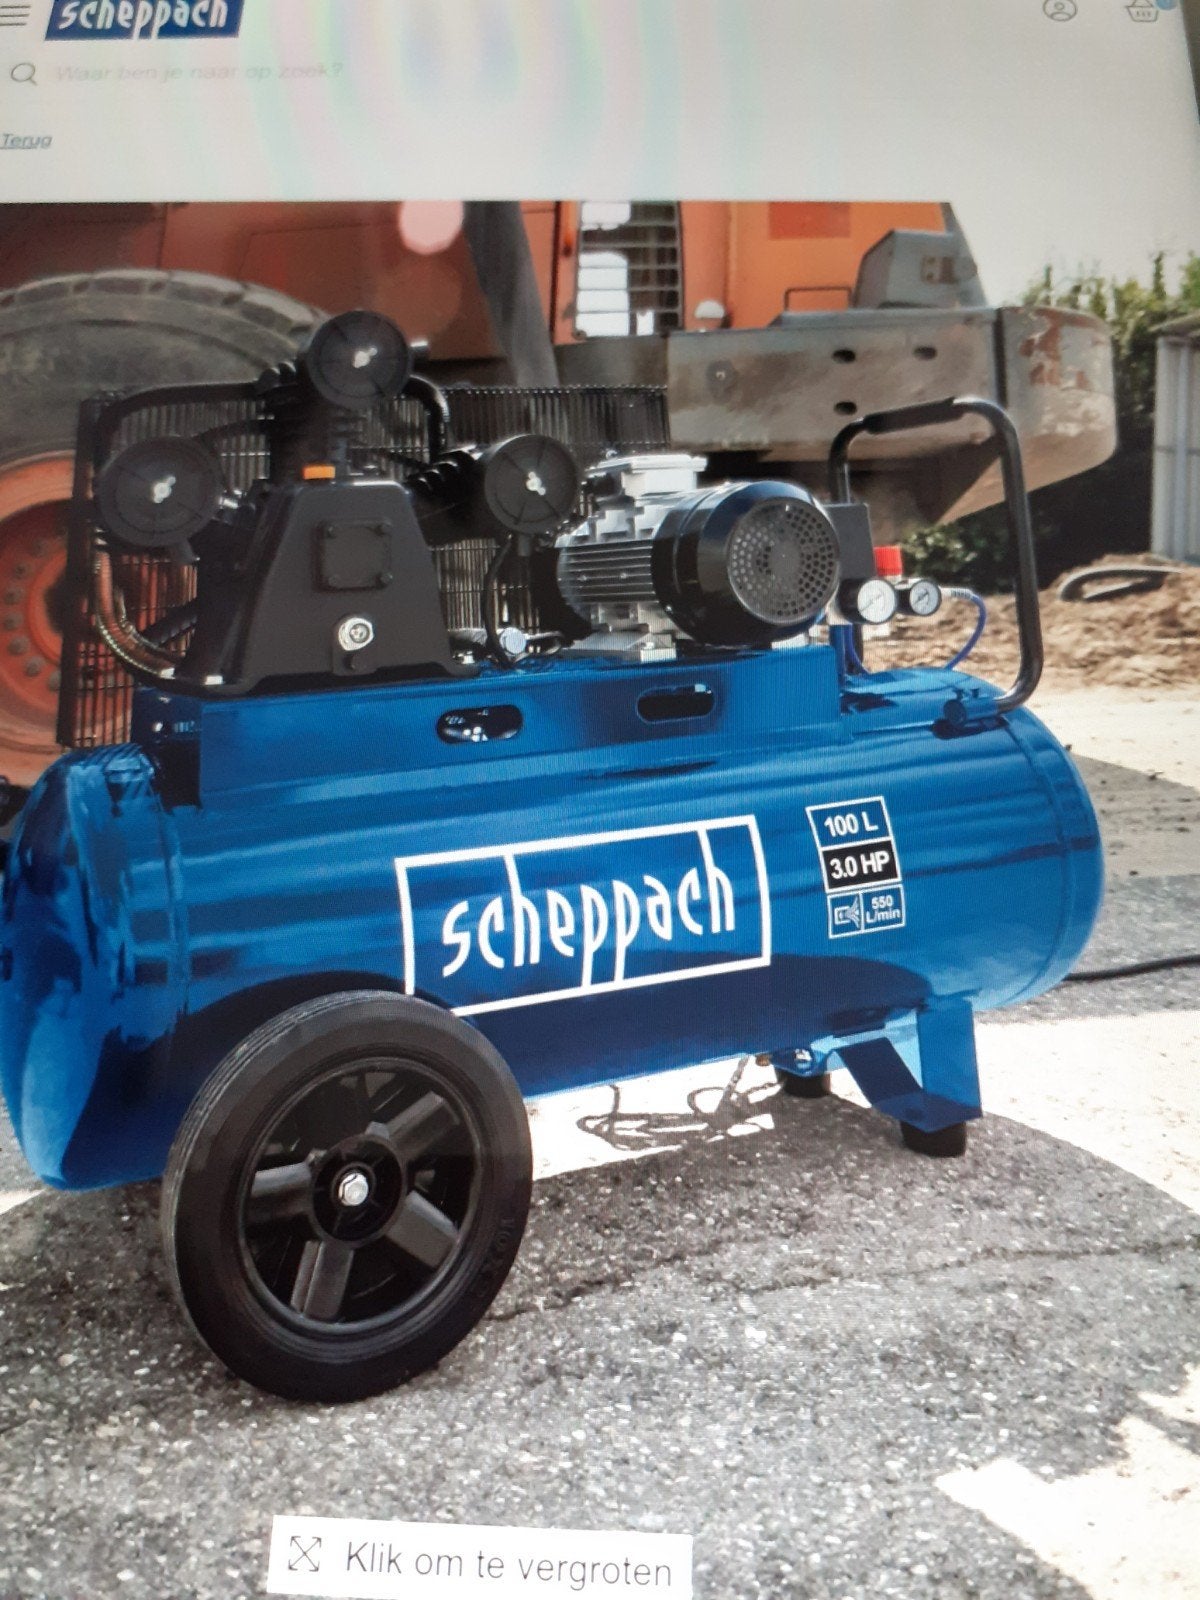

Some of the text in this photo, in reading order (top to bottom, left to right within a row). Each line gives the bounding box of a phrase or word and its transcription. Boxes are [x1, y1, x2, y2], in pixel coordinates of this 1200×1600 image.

[58, 0, 228, 40] scheppach
[56, 65, 111, 81] Waar
[118, 64, 157, 80] ben
[161, 65, 182, 83] je
[190, 67, 237, 80] naar
[245, 66, 271, 81] op
[2, 132, 53, 150] Terug
[824, 811, 879, 837] 100 L
[830, 850, 890, 879] 3.0 HP
[442, 826, 735, 988] scheppach
[871, 894, 893, 910] 550
[866, 908, 901, 923] L/min
[346, 1541, 671, 1591] Klik om te vergroten
